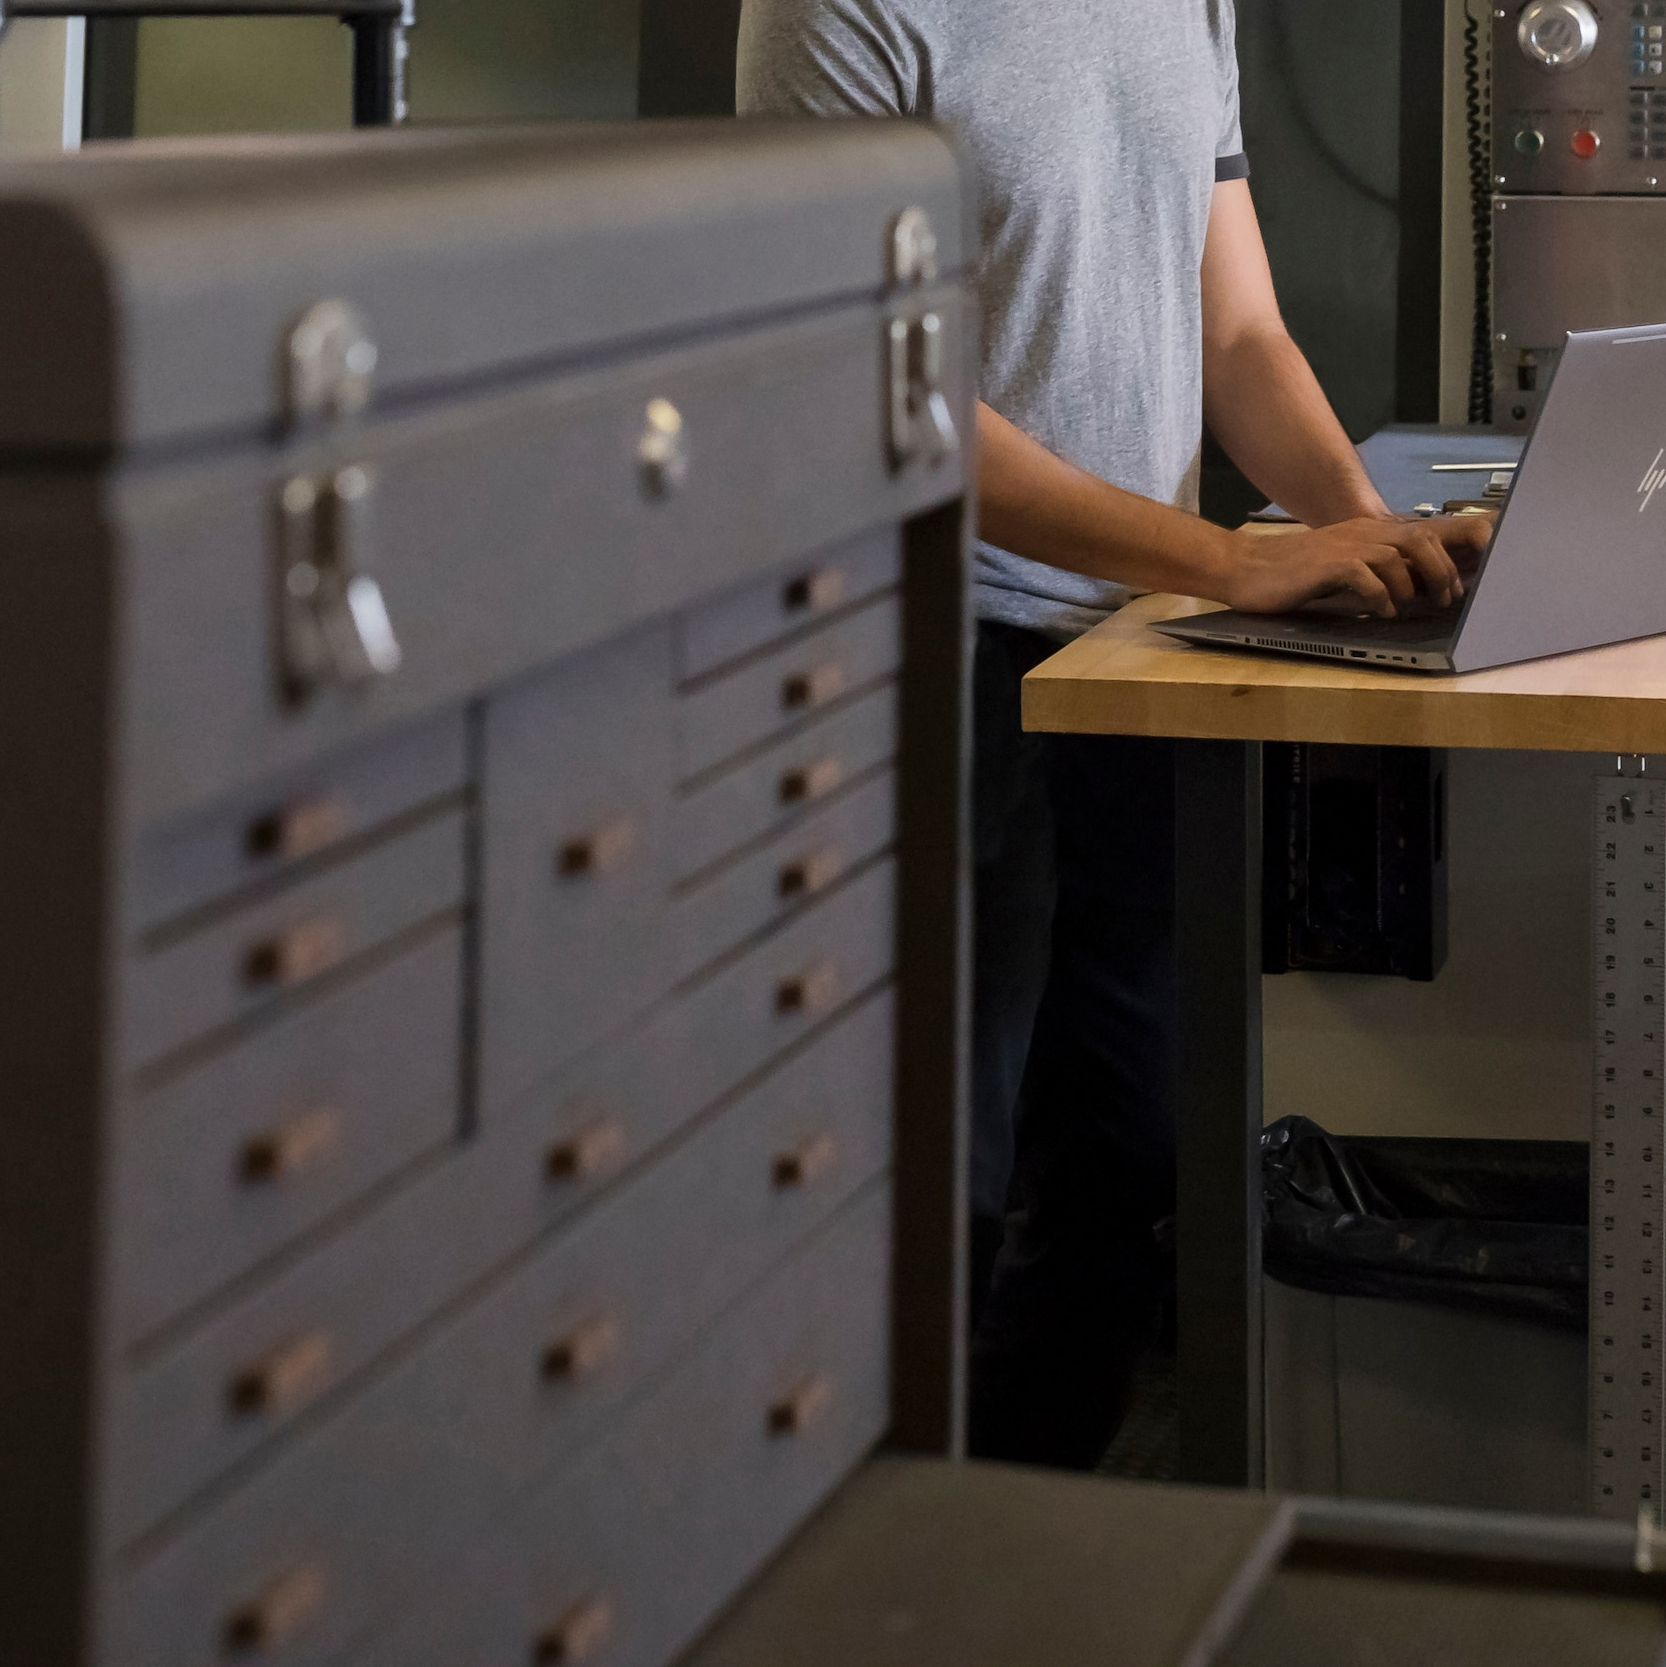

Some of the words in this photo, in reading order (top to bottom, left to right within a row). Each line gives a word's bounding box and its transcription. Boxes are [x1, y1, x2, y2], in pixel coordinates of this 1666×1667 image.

[1606, 805, 1615, 823] 23
[1606, 842, 1615, 860] 22
[1606, 881, 1615, 897] 21
[1606, 917, 1615, 934] 20
[1605, 955, 1615, 970] 19
[1605, 992, 1615, 1008] 18
[1605, 1029, 1615, 1045] 17
[1605, 1067, 1615, 1082] 16
[1605, 1104, 1615, 1119] 15
[1605, 1141, 1614, 1157] 14
[1643, 1147, 1652, 1162] 10
[1605, 1179, 1614, 1194] 13
[1643, 1185, 1652, 1198] 11
[1605, 1216, 1614, 1231] 12
[1643, 1222, 1652, 1237] 12
[1605, 1254, 1614, 1269] 11
[1643, 1259, 1652, 1274] 13
[1605, 1291, 1614, 1306] 10
[1643, 1297, 1652, 1311] 14
[1641, 1409, 1651, 1424] 17
